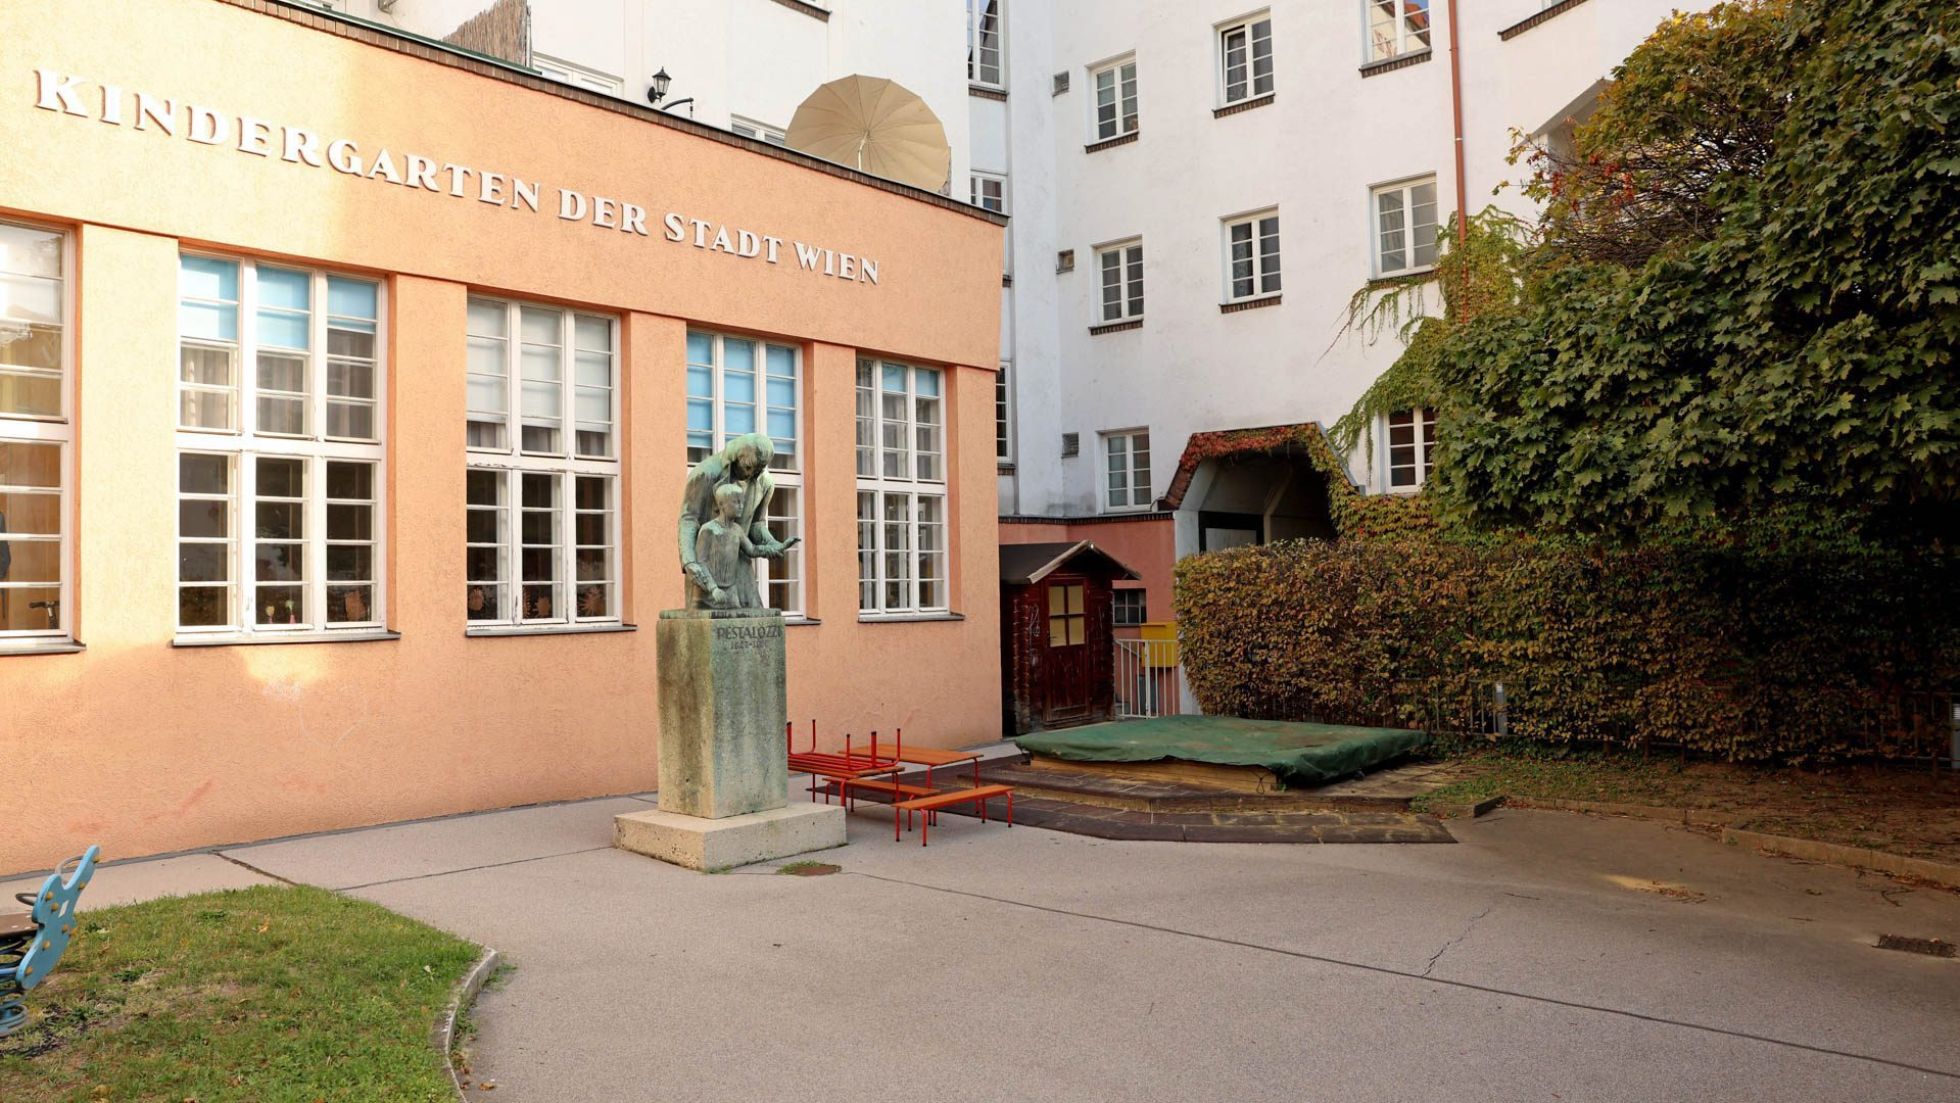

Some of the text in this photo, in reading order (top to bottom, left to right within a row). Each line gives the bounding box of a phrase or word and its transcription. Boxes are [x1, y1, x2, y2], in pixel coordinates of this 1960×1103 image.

[34, 68, 880, 285] KINDERGARTEN DER STADT WIEN
[716, 624, 783, 640] PESTALOZZI
